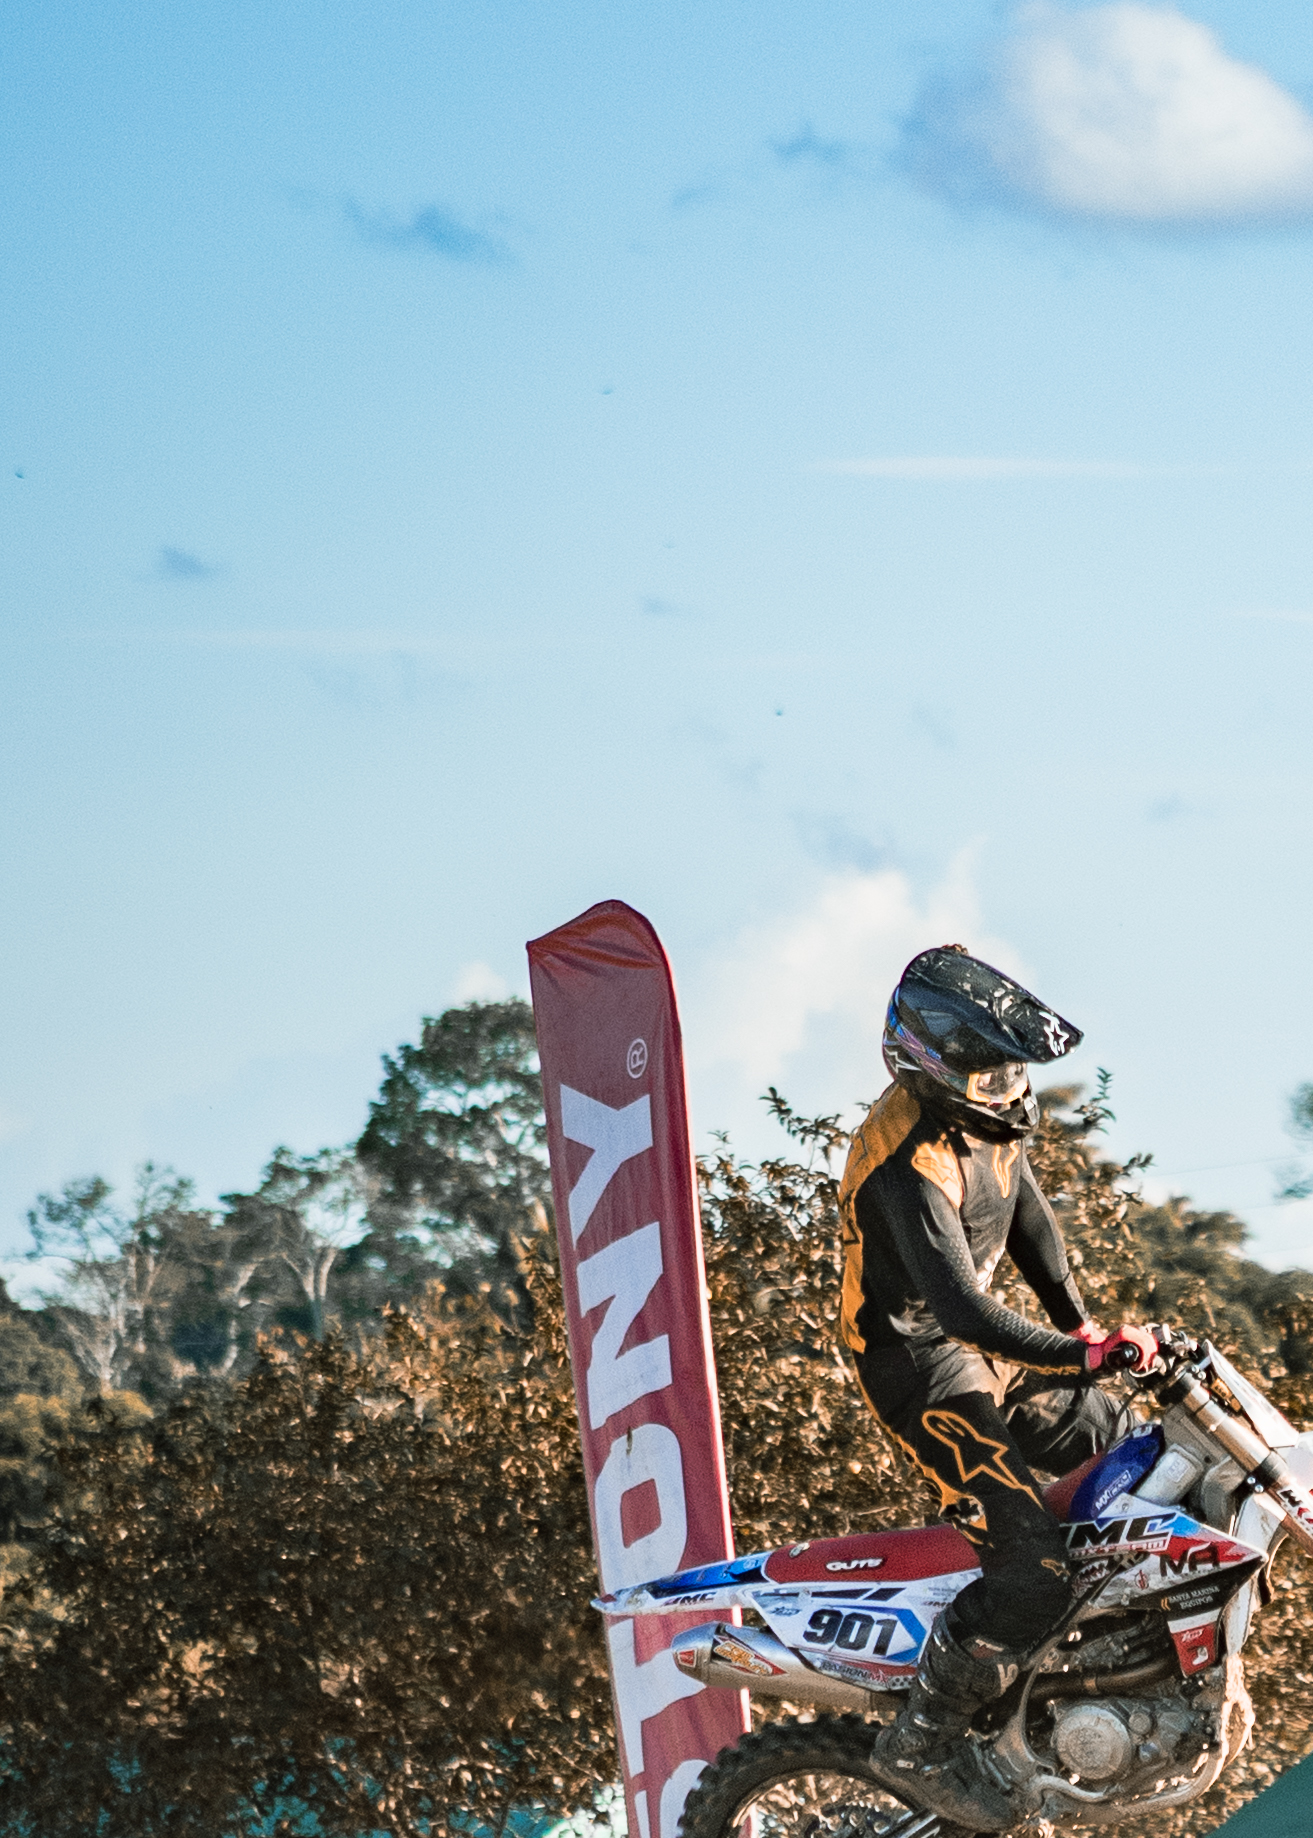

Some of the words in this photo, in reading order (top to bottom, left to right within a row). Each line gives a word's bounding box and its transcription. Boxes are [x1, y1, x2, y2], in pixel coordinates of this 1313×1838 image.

[1060, 1512, 1177, 1550] MC
[826, 1558, 883, 1571] GUTS
[803, 1608, 898, 1656] 901
